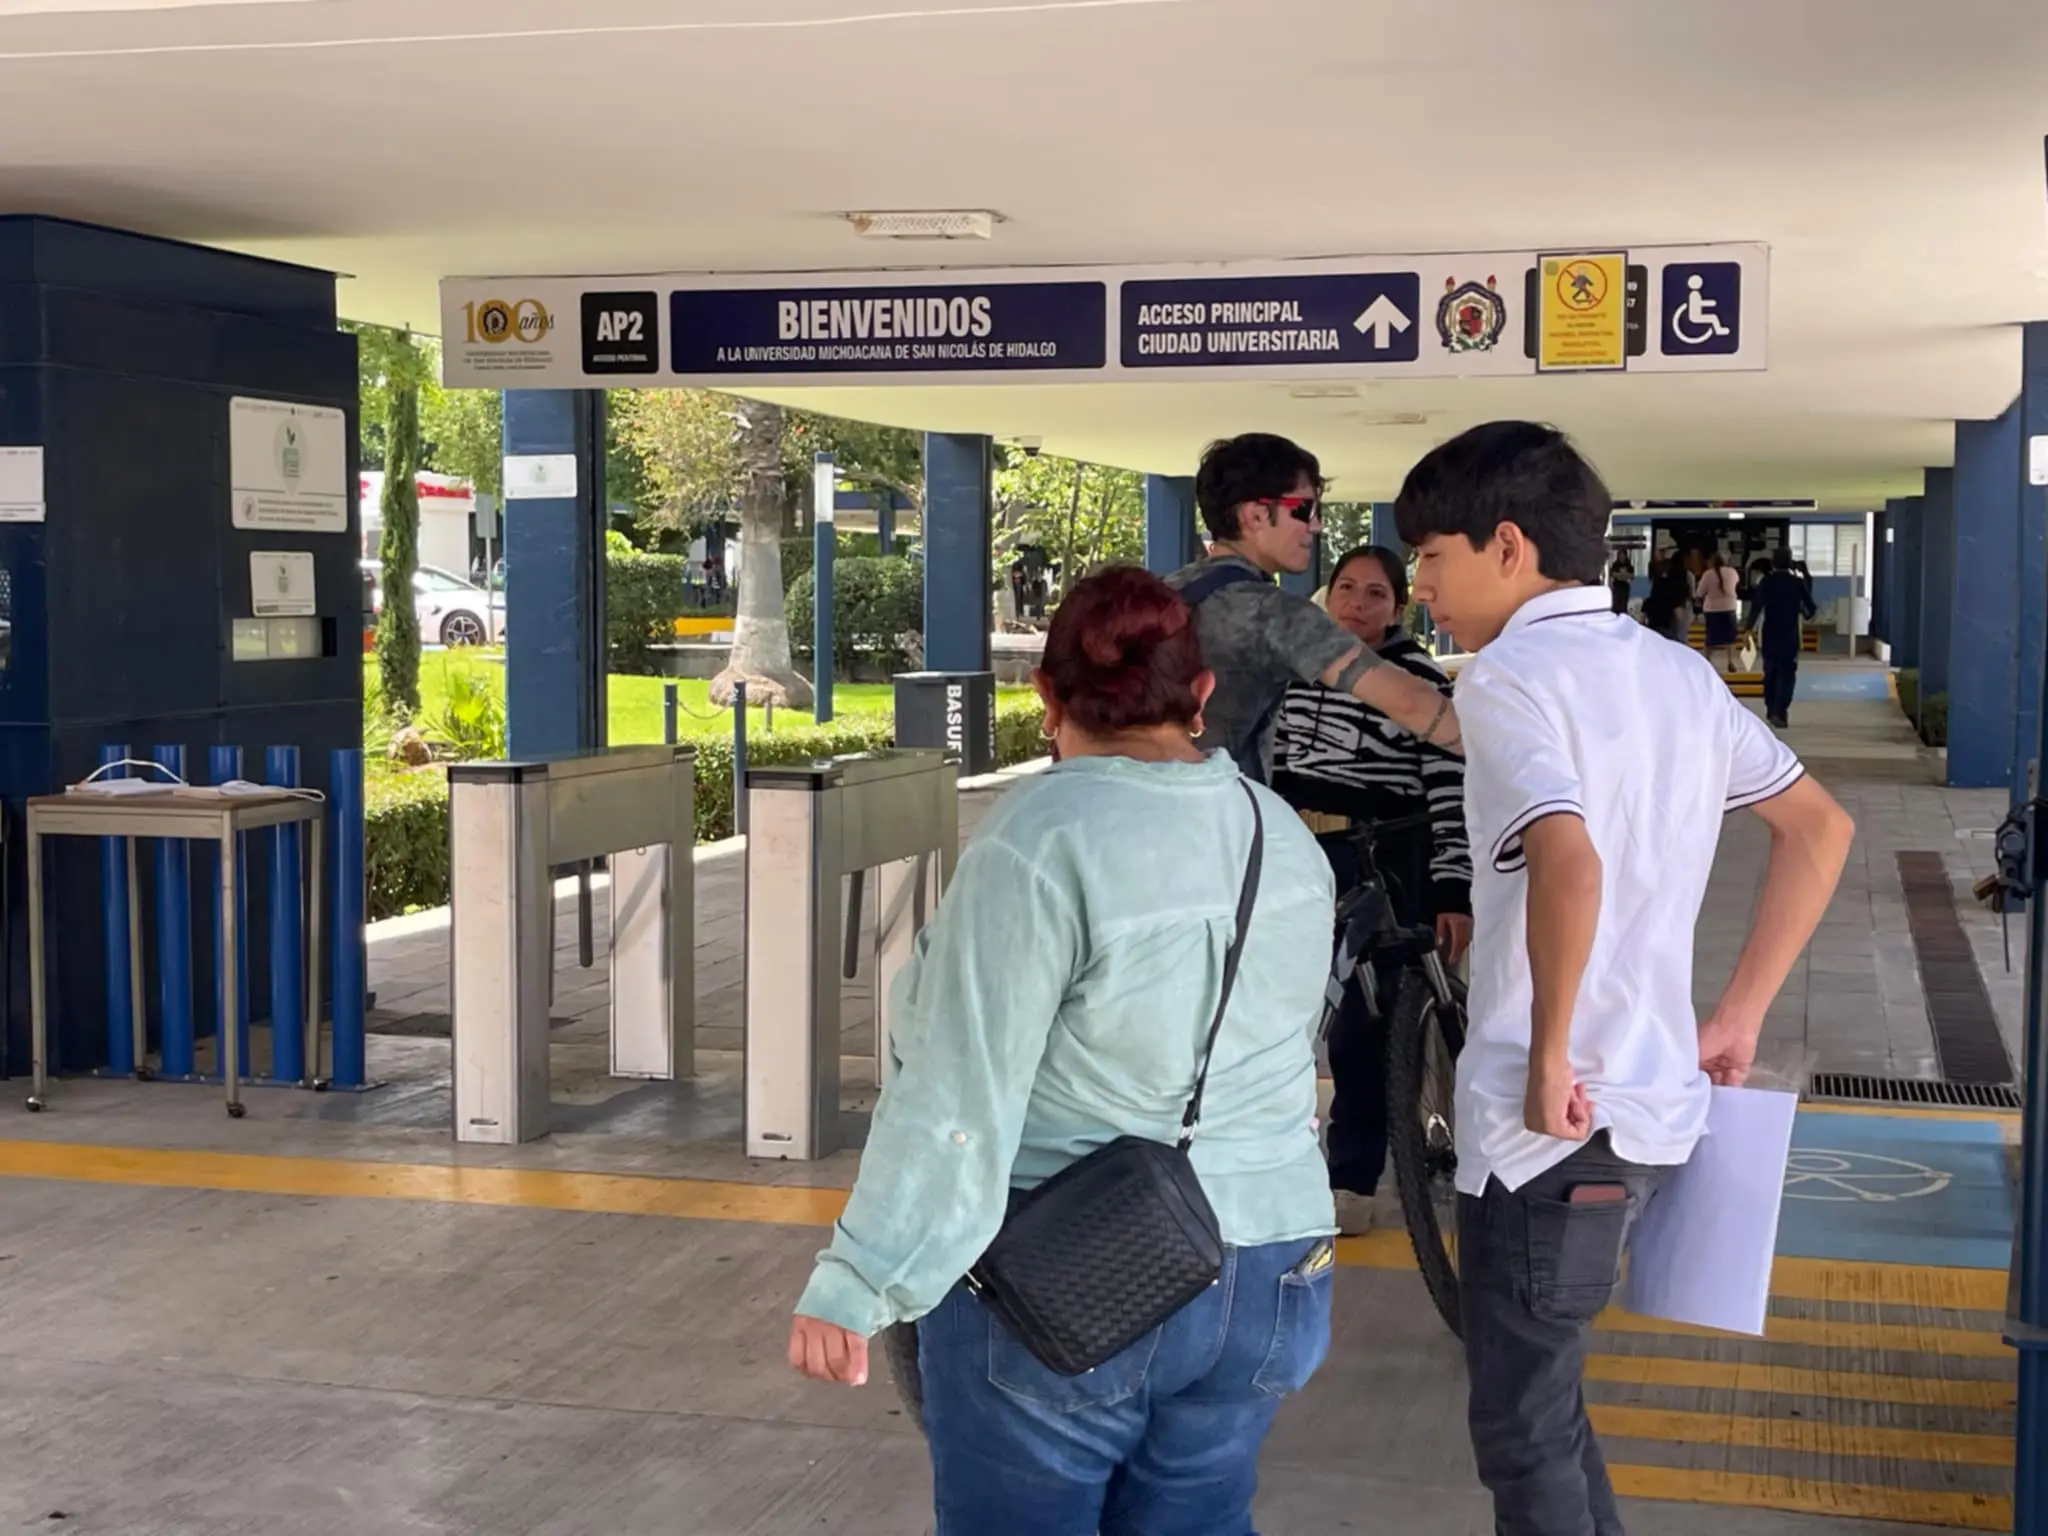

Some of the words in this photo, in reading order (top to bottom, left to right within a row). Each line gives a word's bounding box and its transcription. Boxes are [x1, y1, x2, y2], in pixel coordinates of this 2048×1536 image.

[461, 299, 547, 344] 100
[518, 312, 555, 330] años
[596, 311, 645, 342] AP2
[778, 296, 992, 341] BIENVENIDOS
[1137, 302, 1206, 326] ACCESO
[1210, 300, 1303, 325] PRINCIPAL
[717, 347, 726, 361] A
[728, 347, 742, 361] LA
[744, 345, 816, 362] UNIVERSIDAD
[818, 344, 893, 361] MICHOACANA
[895, 343, 910, 359] DE
[912, 343, 936, 359] SAN
[938, 340, 986, 359] NICOLÁS
[988, 342, 1004, 358] DE
[1006, 341, 1057, 358] HIDALGO
[1137, 332, 1202, 354] CIUDAD
[1206, 328, 1340, 353] UNIVERSITARIA
